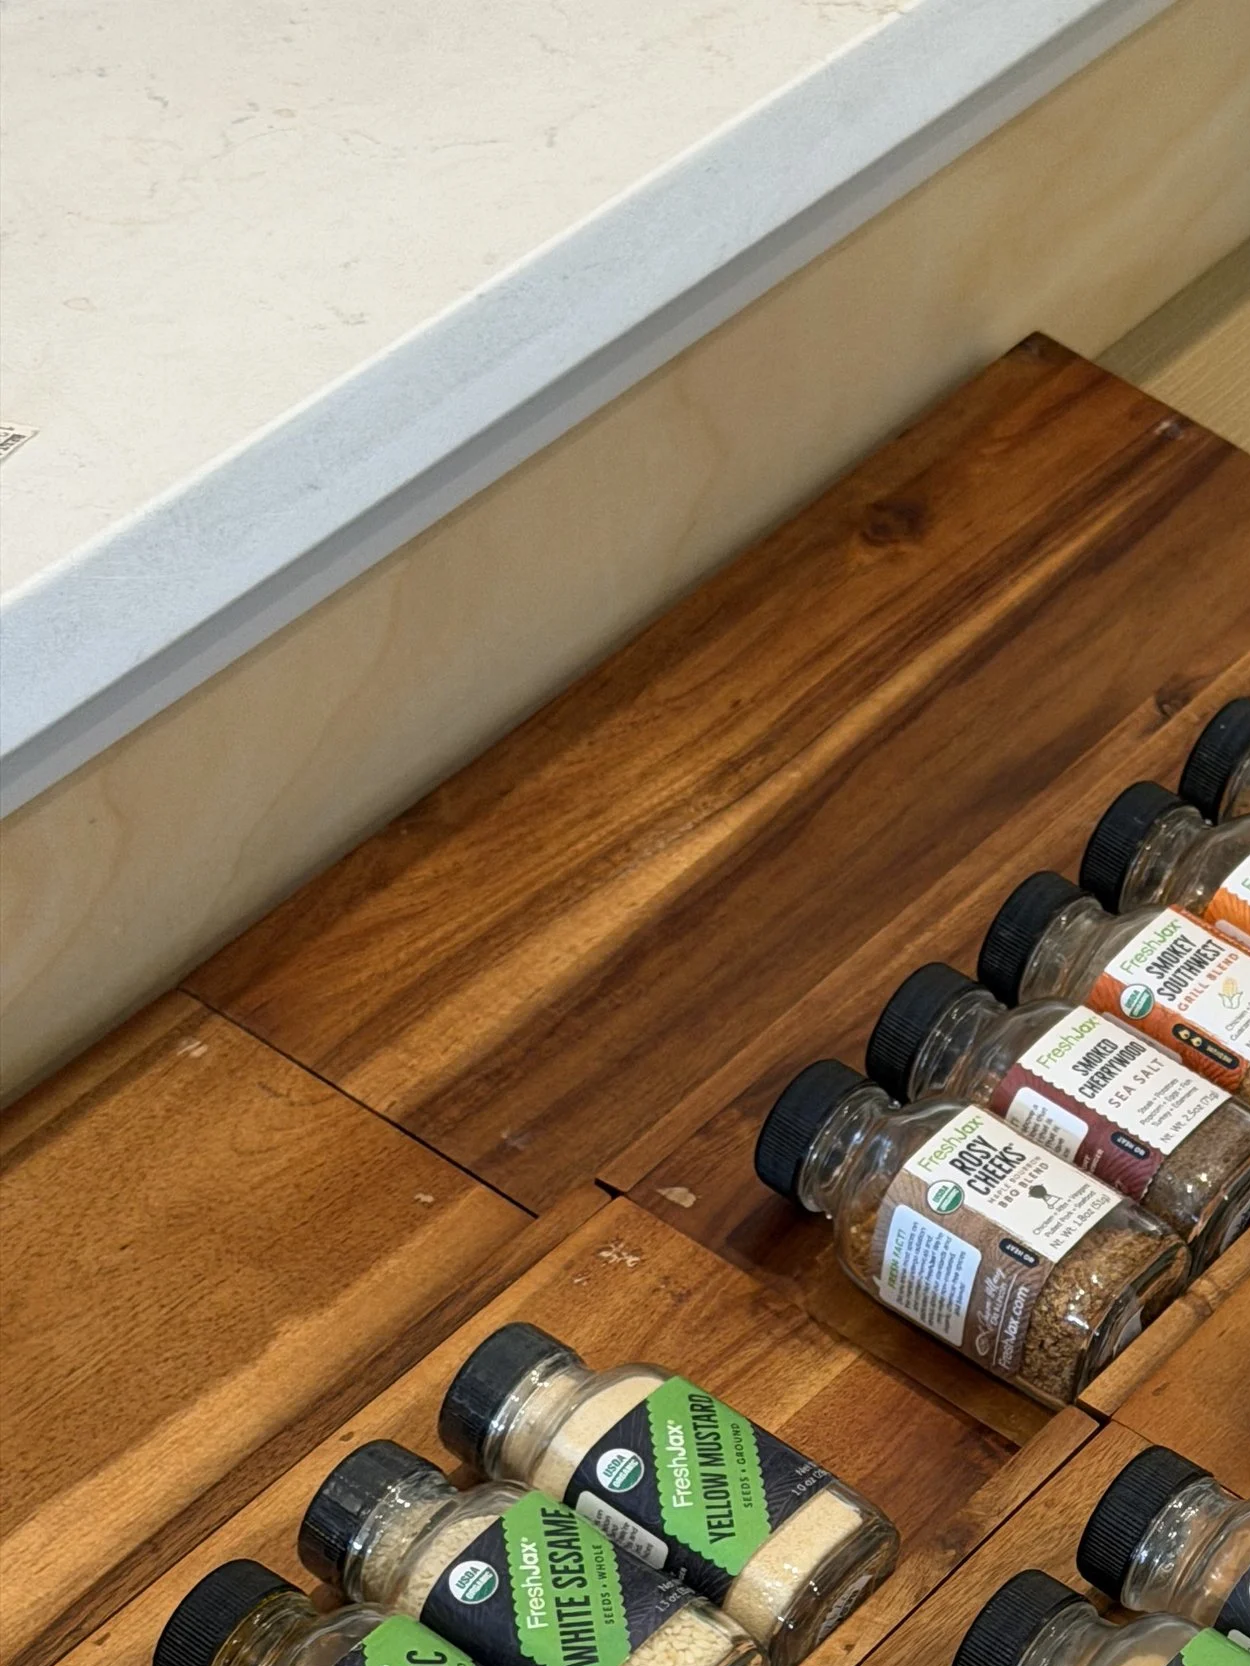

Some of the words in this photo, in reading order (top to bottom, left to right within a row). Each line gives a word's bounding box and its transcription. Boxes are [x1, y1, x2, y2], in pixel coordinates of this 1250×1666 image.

[1146, 935, 1197, 979] SMOKEY
[1158, 939, 1225, 1001] SOUTHWEST
[1178, 982, 1209, 1012] GRILL
[1208, 953, 1239, 982] BLEND
[1072, 1038, 1118, 1076] SMOKED
[1079, 1041, 1146, 1099] CHERRYWOOD
[1108, 1084, 1135, 1108] SEA
[1134, 1059, 1164, 1085] SALT
[919, 1116, 983, 1172] FreshJax
[949, 1136, 998, 1176] ROSY
[967, 1145, 1026, 1196] CHEEKS
[998, 1190, 1020, 1209] BBQ
[1020, 1163, 1049, 1188] BLEND
[688, 1394, 719, 1467] MUSTARD
[731, 1423, 746, 1466] GROUND
[602, 1454, 625, 1477] USDA
[612, 1460, 638, 1487] ORGANIC
[667, 1421, 693, 1508] FreshJax
[699, 1474, 736, 1545] YELLOW
[742, 1476, 754, 1511] SEEDS
[541, 1507, 588, 1589] SESAME
[593, 1544, 607, 1580] WHOLE
[519, 1537, 548, 1630] FreshJax
[603, 1592, 615, 1625] SEEDS
